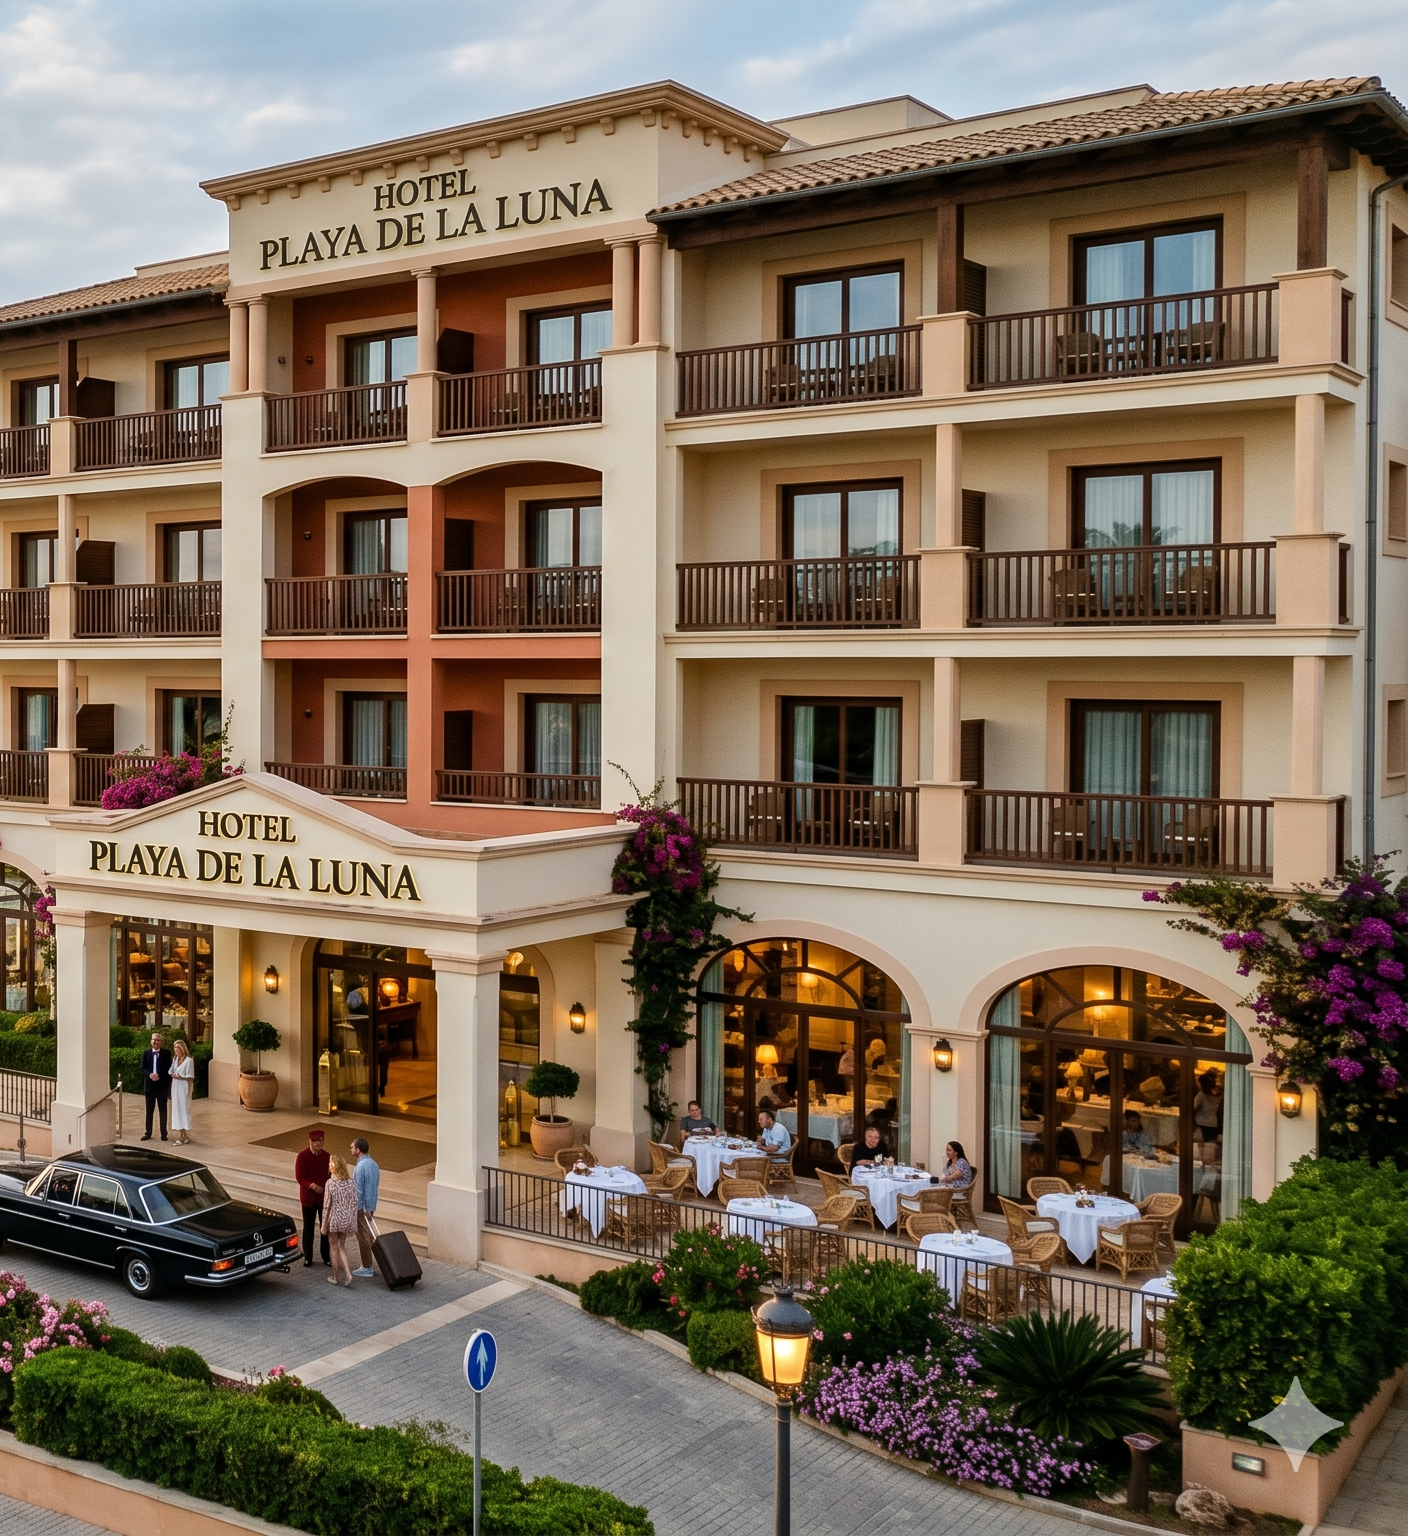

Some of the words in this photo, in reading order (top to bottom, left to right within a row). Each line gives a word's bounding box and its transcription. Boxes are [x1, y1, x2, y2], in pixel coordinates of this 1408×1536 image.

[373, 168, 477, 212] HOTEL
[259, 223, 368, 271] PLAYA
[376, 212, 426, 252] DE
[435, 202, 487, 241] LA
[495, 178, 613, 231] LUNA
[197, 810, 297, 843] HOTEL
[88, 840, 189, 880] PLAYA
[195, 849, 244, 885] DE
[252, 853, 301, 891] LA
[308, 857, 422, 902] LUNA
